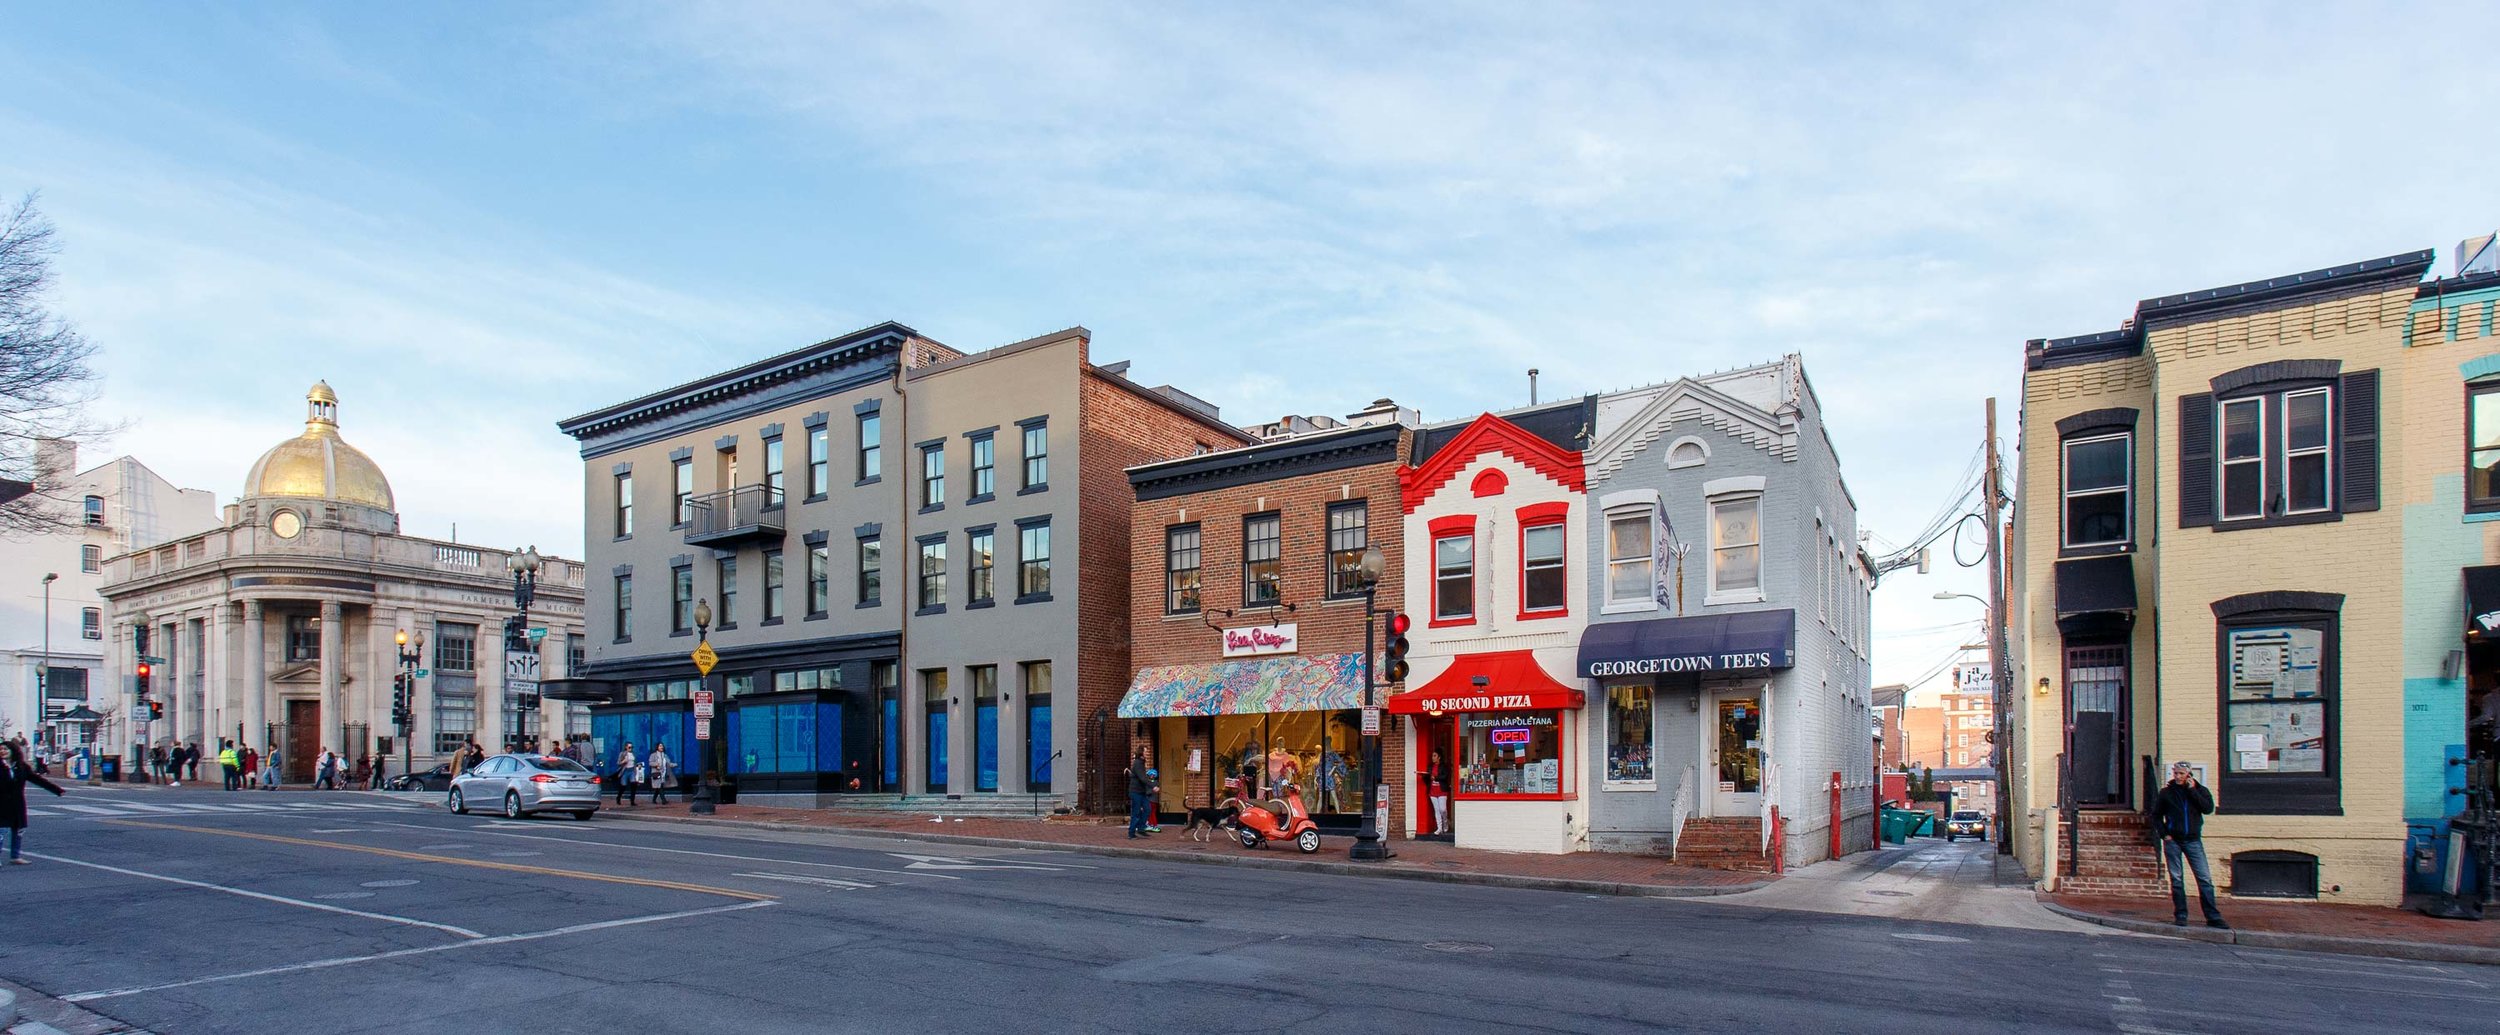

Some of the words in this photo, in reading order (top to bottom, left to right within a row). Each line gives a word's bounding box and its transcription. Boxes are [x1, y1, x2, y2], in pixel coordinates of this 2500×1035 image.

[461, 595, 507, 605] FARMERS
[1590, 655, 1713, 677] GEORGETOWN
[1720, 652, 1771, 669] TEE'S
[1422, 699, 1438, 711] 90
[1440, 697, 1490, 710] SECOND
[1493, 695, 1532, 708] PIZZA
[1467, 719, 1501, 727] PIZZERIA
[1501, 717, 1553, 726] NAPOLETANA
[1495, 731, 1528, 741] OPEN
